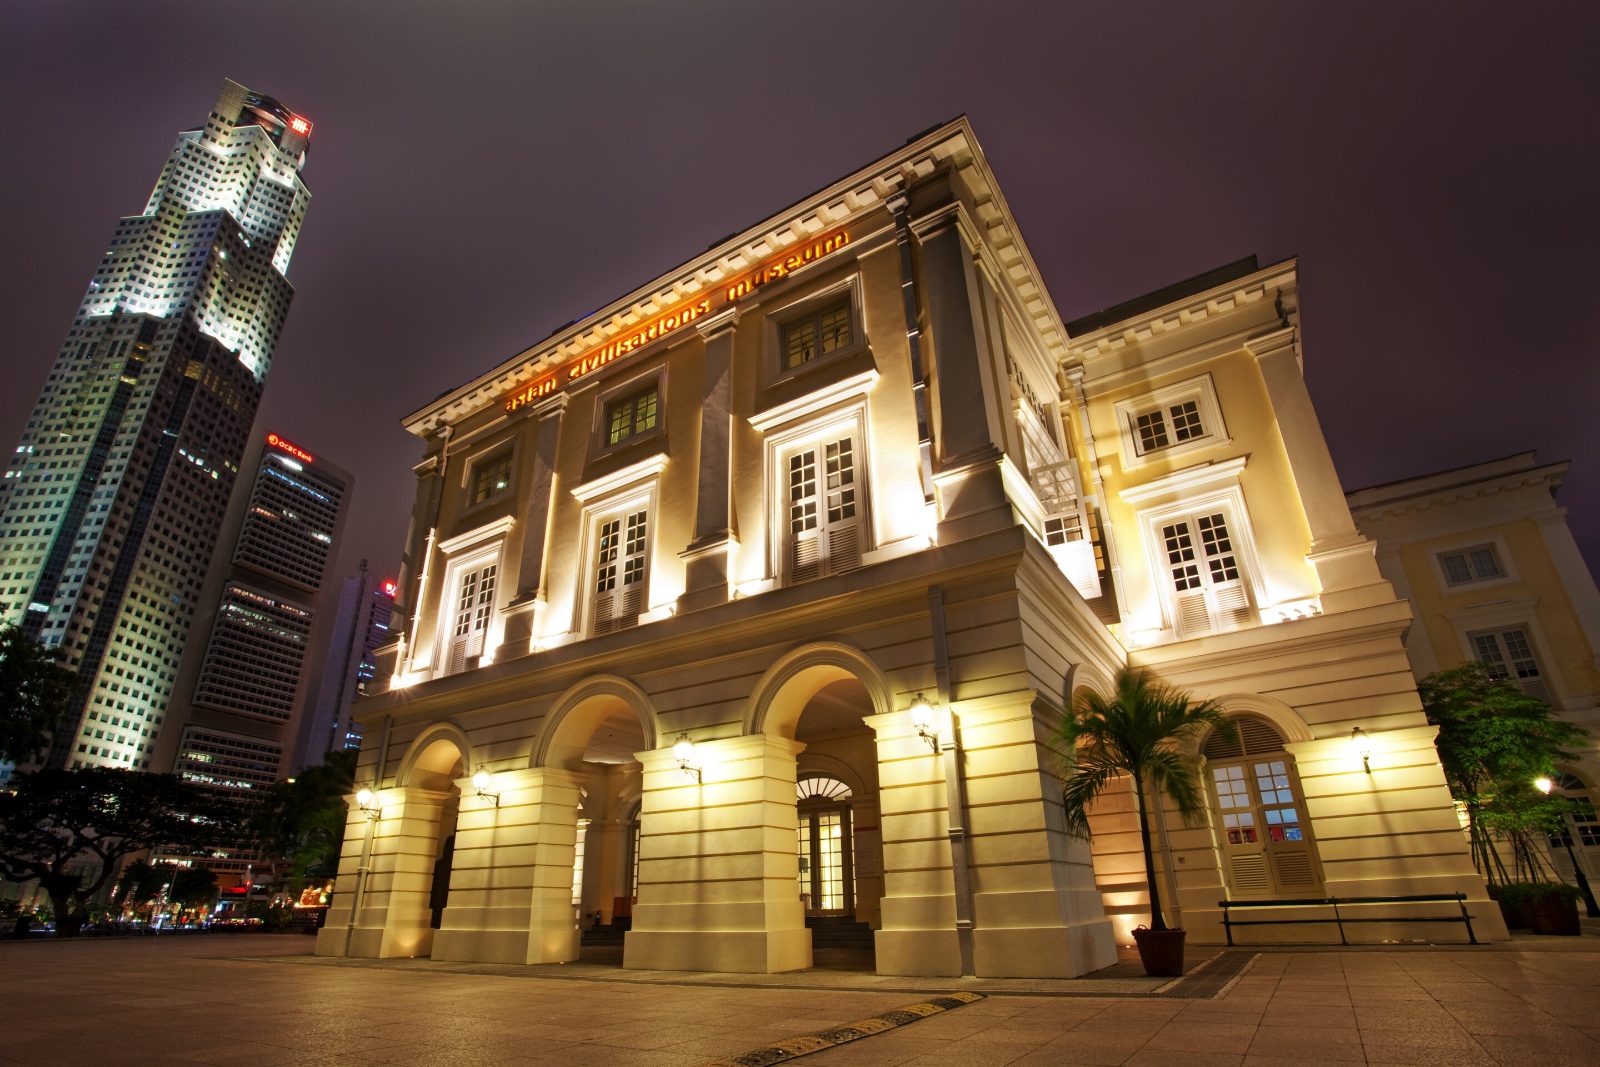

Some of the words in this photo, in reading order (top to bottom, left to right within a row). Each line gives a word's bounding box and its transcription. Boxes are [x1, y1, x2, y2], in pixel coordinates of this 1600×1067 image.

[504, 377, 557, 414] asian
[568, 300, 710, 381] civilisations
[726, 231, 849, 301] museum
[279, 441, 297, 454] OCBC
[297, 450, 312, 463] Bank
